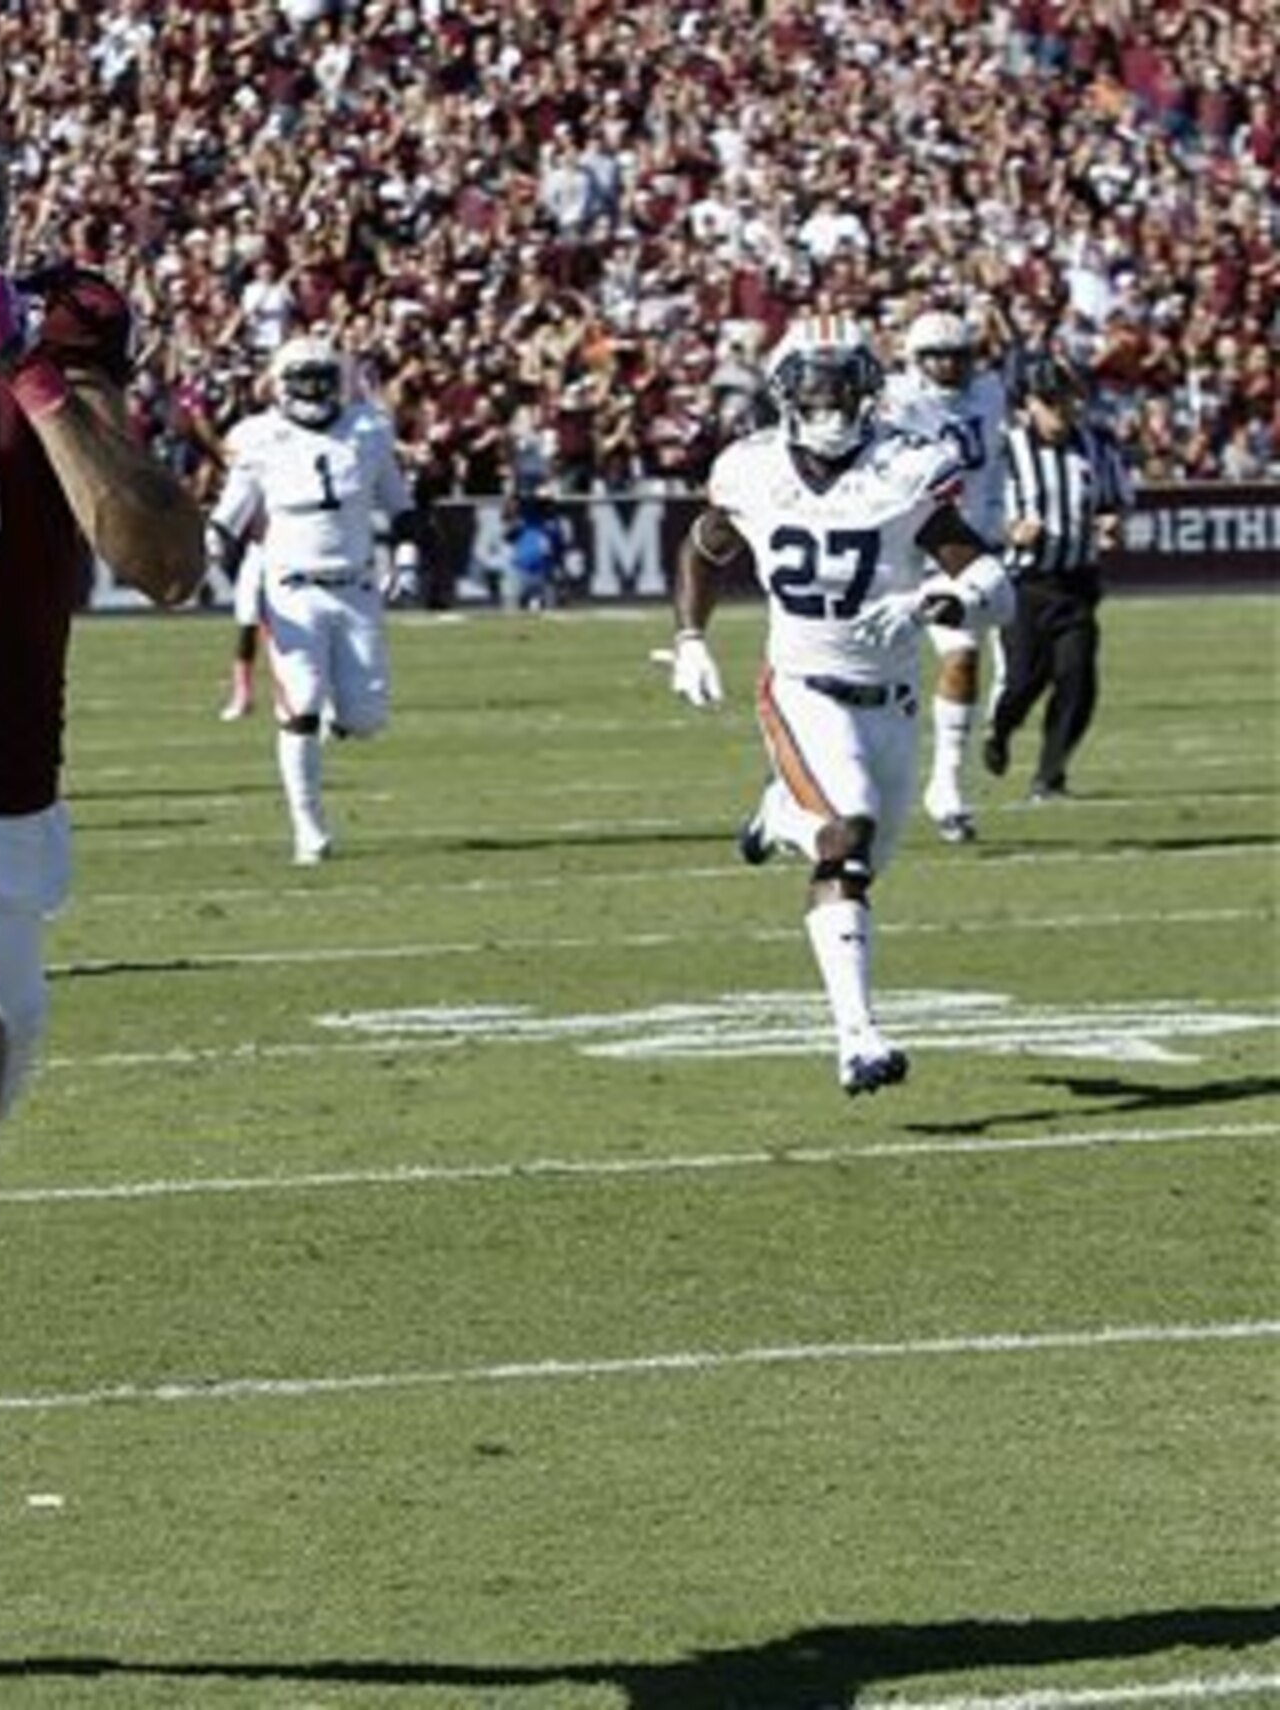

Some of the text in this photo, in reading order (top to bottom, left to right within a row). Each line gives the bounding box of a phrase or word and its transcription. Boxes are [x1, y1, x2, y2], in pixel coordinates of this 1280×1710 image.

[314, 453, 342, 510] 1
[1125, 506, 1280, 553] #12TH
[770, 525, 880, 619] 27
